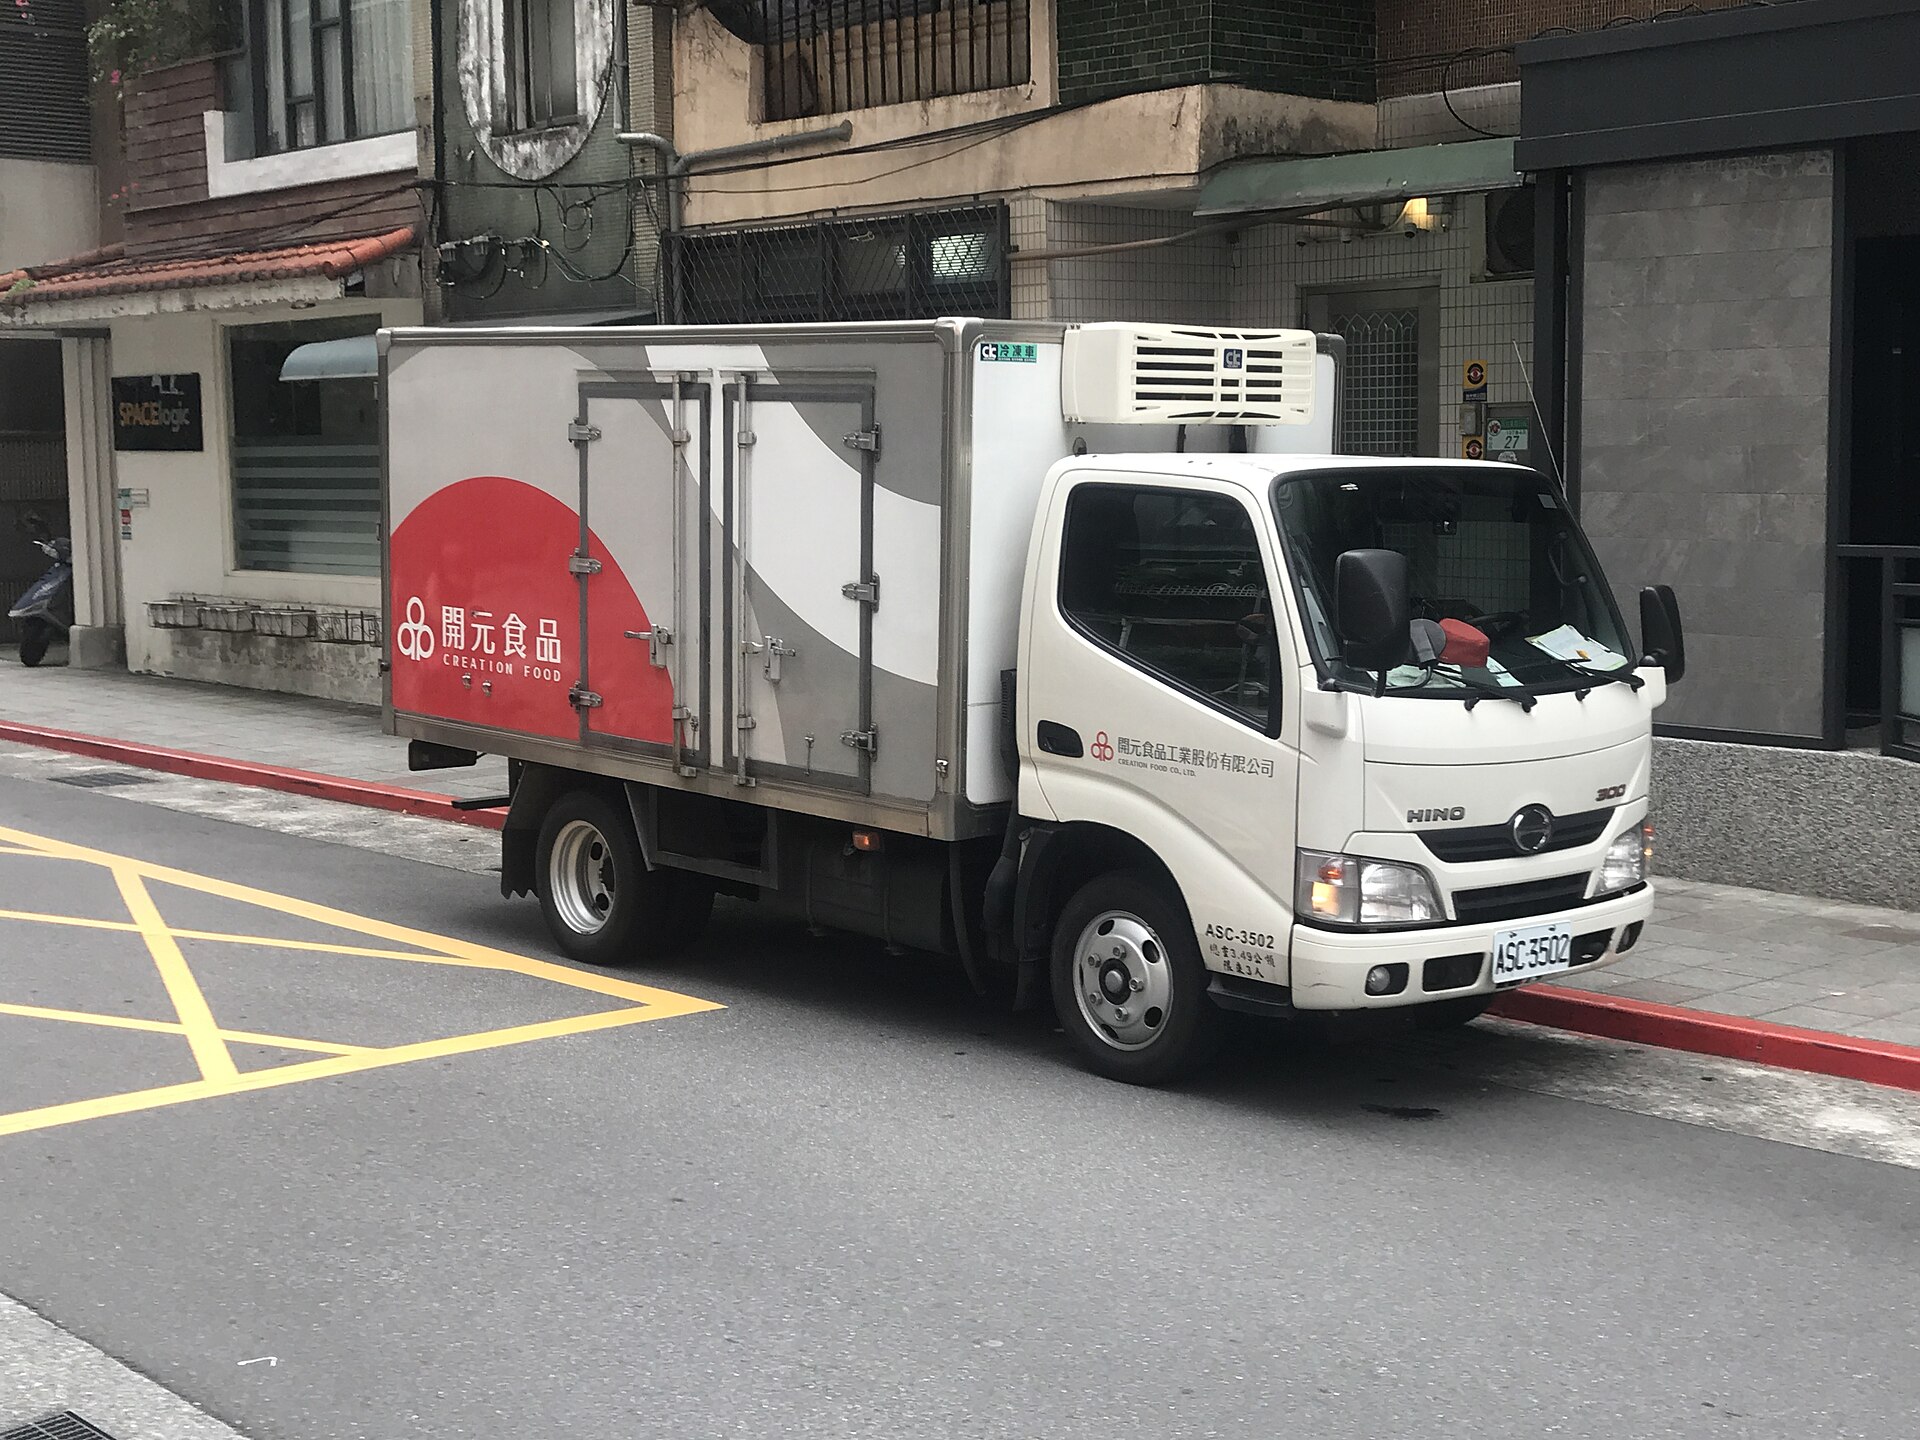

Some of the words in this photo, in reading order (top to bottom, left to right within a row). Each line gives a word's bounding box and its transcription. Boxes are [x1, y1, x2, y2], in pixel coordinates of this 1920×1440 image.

[999, 344, 1035, 358] 冷凍車
[1504, 436, 1520, 448] 27
[442, 606, 561, 663] 開元食品
[443, 653, 514, 676] CREATION
[523, 665, 562, 682] FOOD
[1118, 737, 1274, 777] 開元食品工業股份有限公司
[1119, 759, 1148, 769] CREATION
[1151, 763, 1167, 772] FOOD
[1595, 784, 1627, 802] 300
[1407, 806, 1466, 823] HINO
[1205, 923, 1275, 949] ASC-3502
